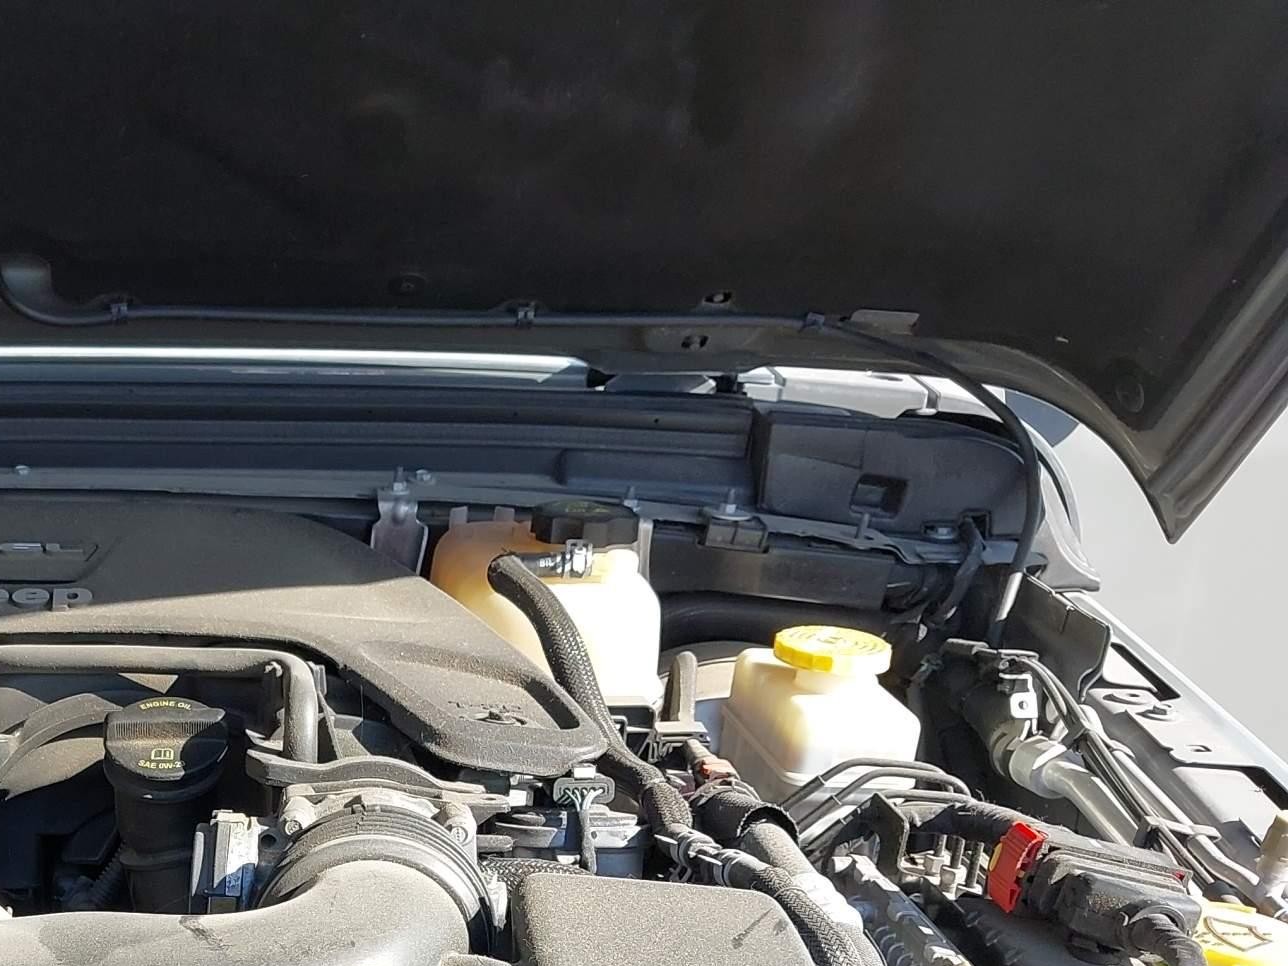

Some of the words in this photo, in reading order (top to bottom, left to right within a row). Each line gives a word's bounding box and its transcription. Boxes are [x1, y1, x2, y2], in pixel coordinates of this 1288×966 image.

[139, 700, 175, 710] ENGINE
[177, 702, 193, 711] OIL
[138, 759, 157, 769] SAE
